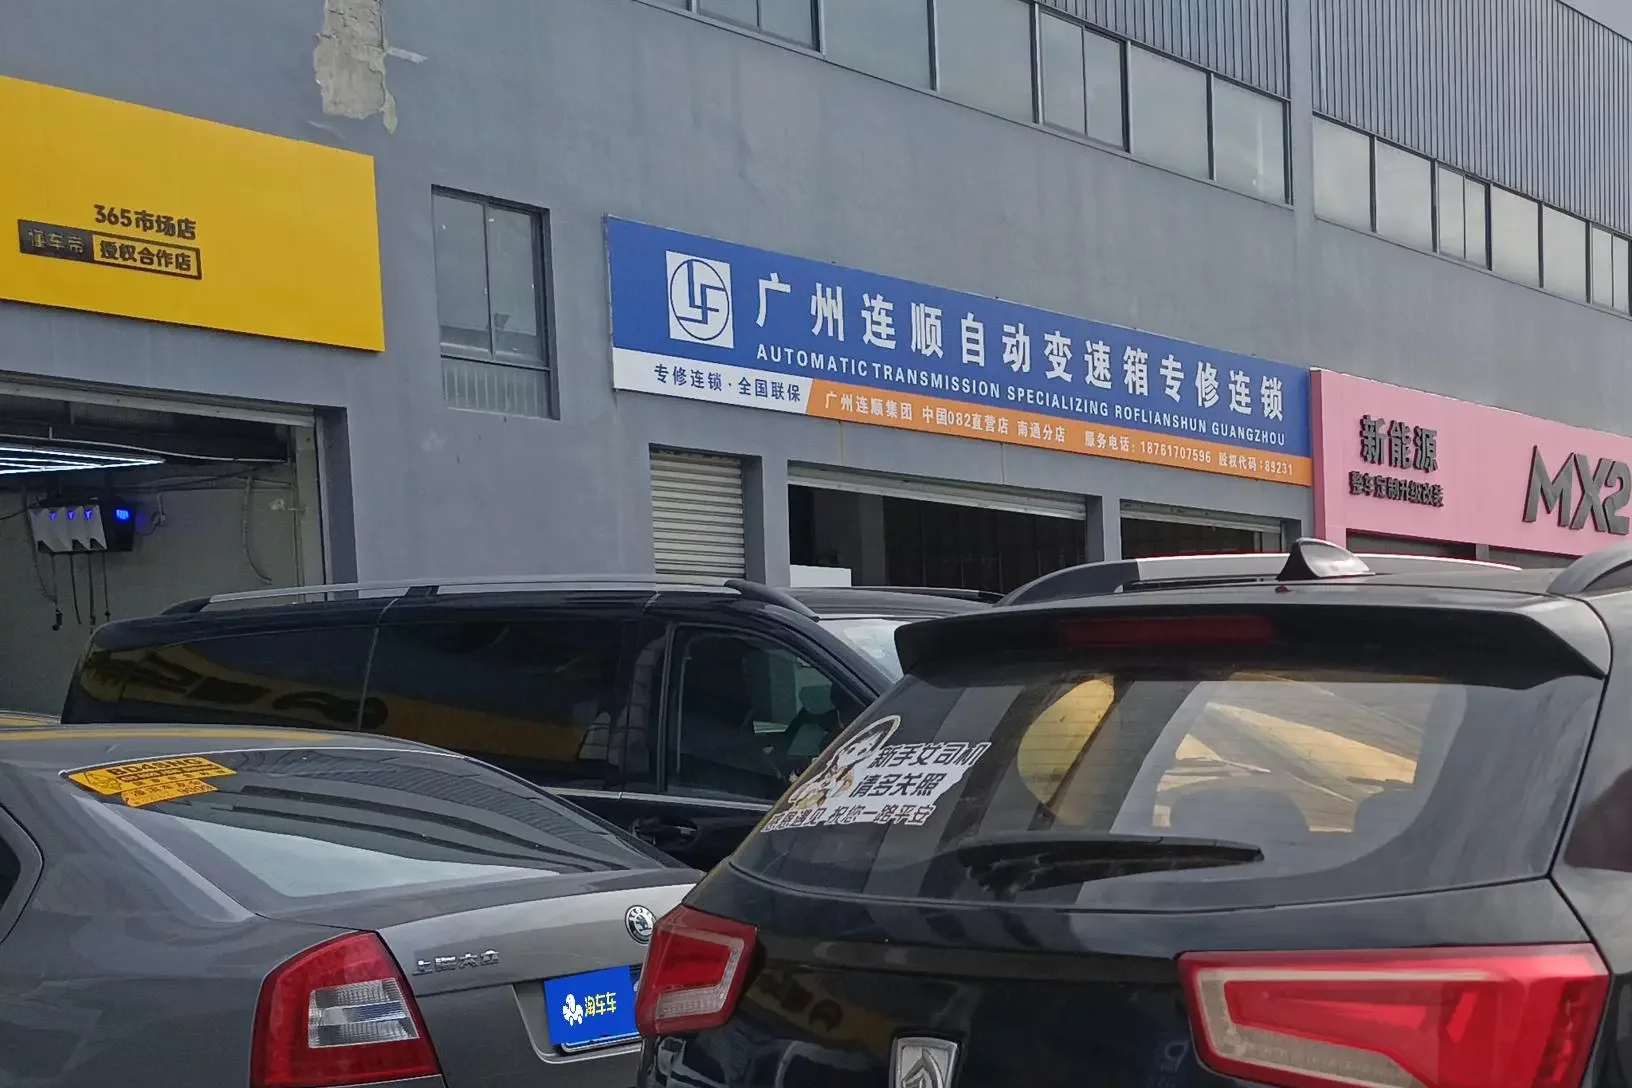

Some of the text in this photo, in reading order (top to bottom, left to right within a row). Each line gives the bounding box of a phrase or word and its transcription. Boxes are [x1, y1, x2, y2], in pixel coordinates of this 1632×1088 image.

[94, 204, 196, 240] 365市场店
[100, 240, 192, 271] 授权合作店
[756, 272, 1285, 422] 广州连顺自动变速箱专修连锁
[756, 344, 1286, 446] AUTOMATIC TRANSMISSION SPECIALIZING ROFLIANSHUN GUANGZHOU
[824, 391, 913, 420] 广州连顺集团
[922, 406, 1009, 435] 中国082直营店
[1017, 420, 1066, 443] 南通分店
[1359, 415, 1438, 473] 新能源
[1522, 445, 1632, 535] MX2
[868, 742, 991, 769] 新手女司机
[849, 773, 947, 798] 请多关照
[828, 804, 936, 826] 祝您一路平安
